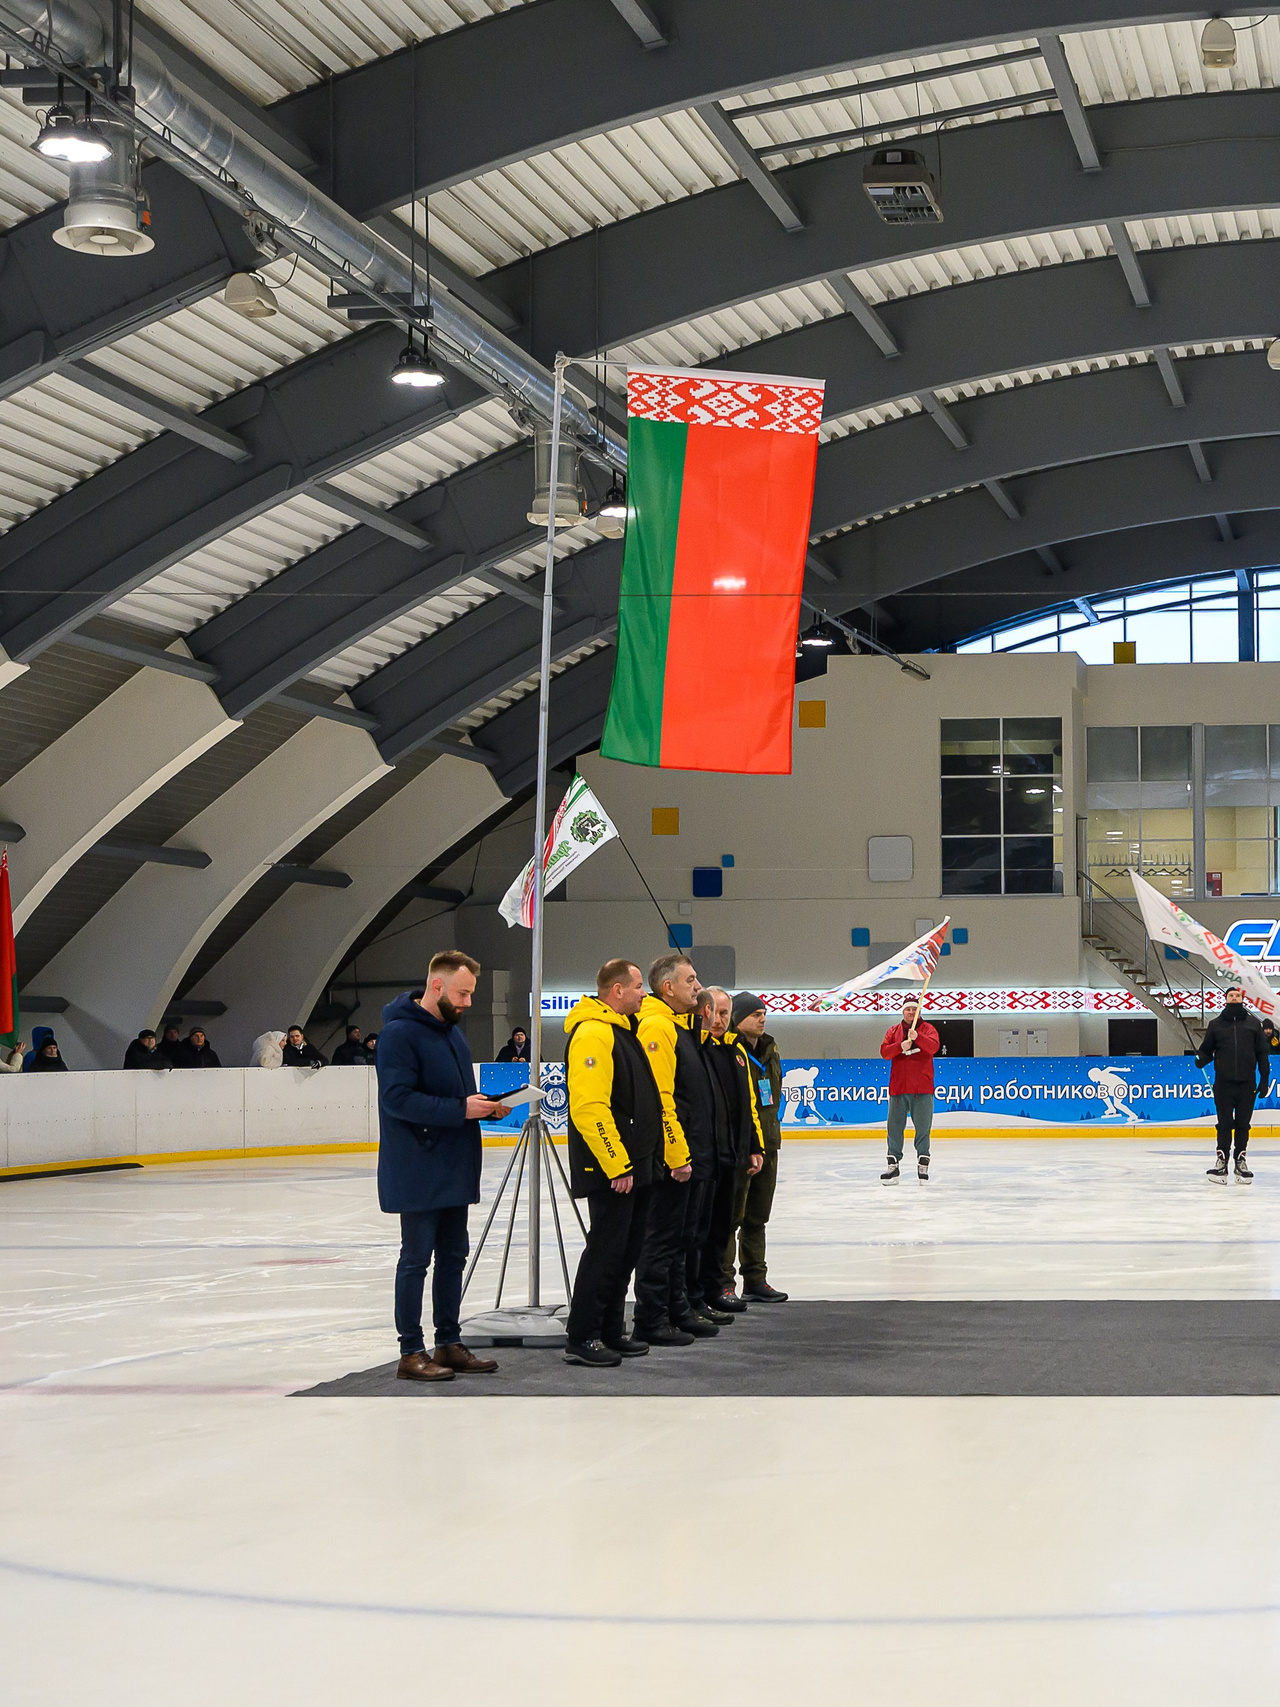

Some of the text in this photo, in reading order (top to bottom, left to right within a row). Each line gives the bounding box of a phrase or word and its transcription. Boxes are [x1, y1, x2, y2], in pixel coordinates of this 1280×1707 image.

[782, 1086, 889, 1105] партакиад
[934, 1085, 973, 1104] еди
[980, 1079, 1109, 1104] работников
[1113, 1083, 1214, 1104] организа
[596, 1122, 616, 1158] BELARUS
